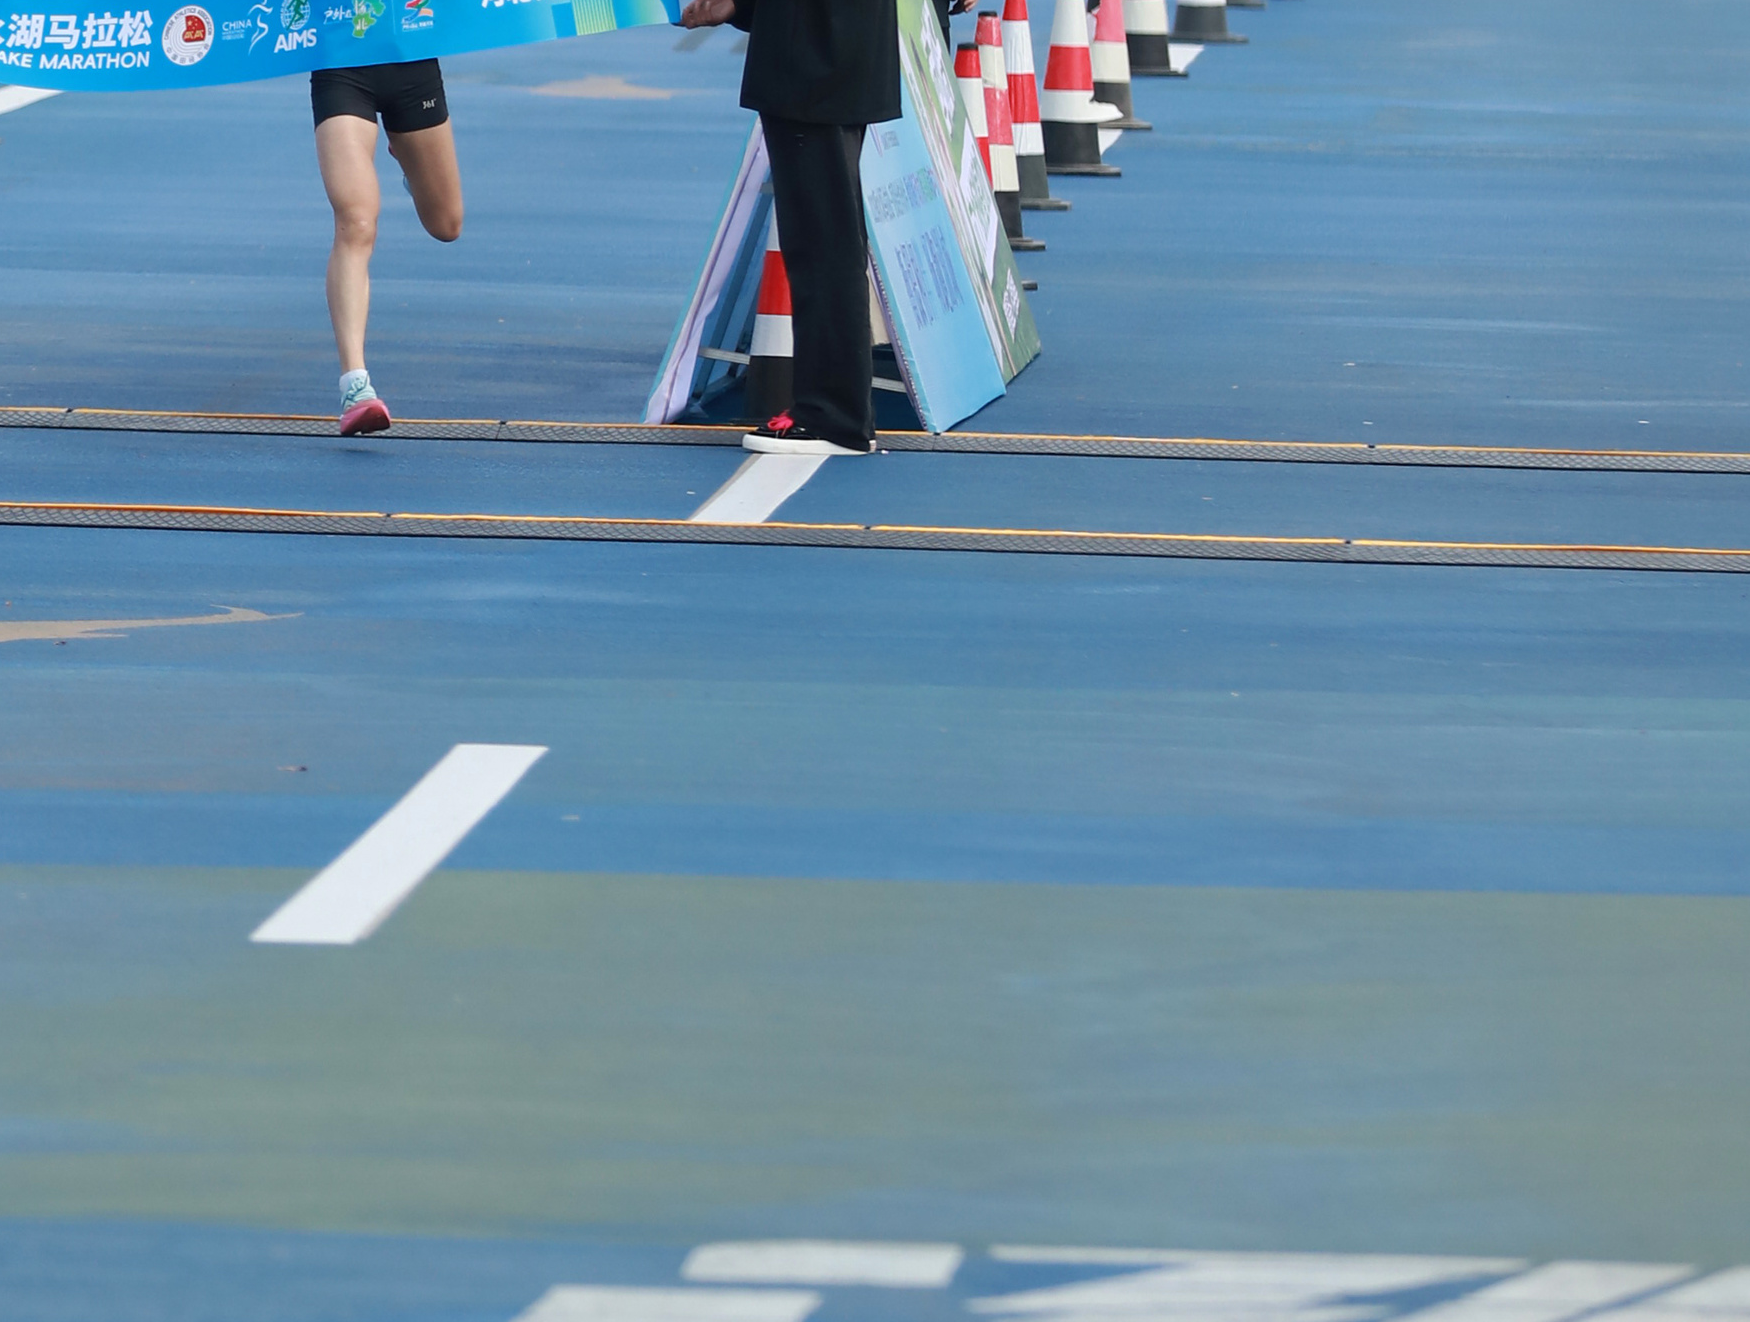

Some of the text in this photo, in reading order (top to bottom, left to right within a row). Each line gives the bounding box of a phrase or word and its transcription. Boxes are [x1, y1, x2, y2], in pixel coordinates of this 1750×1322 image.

[222, 19, 252, 32] CHINA
[274, 28, 317, 54] AIMS
[39, 51, 150, 70] MARATHON
